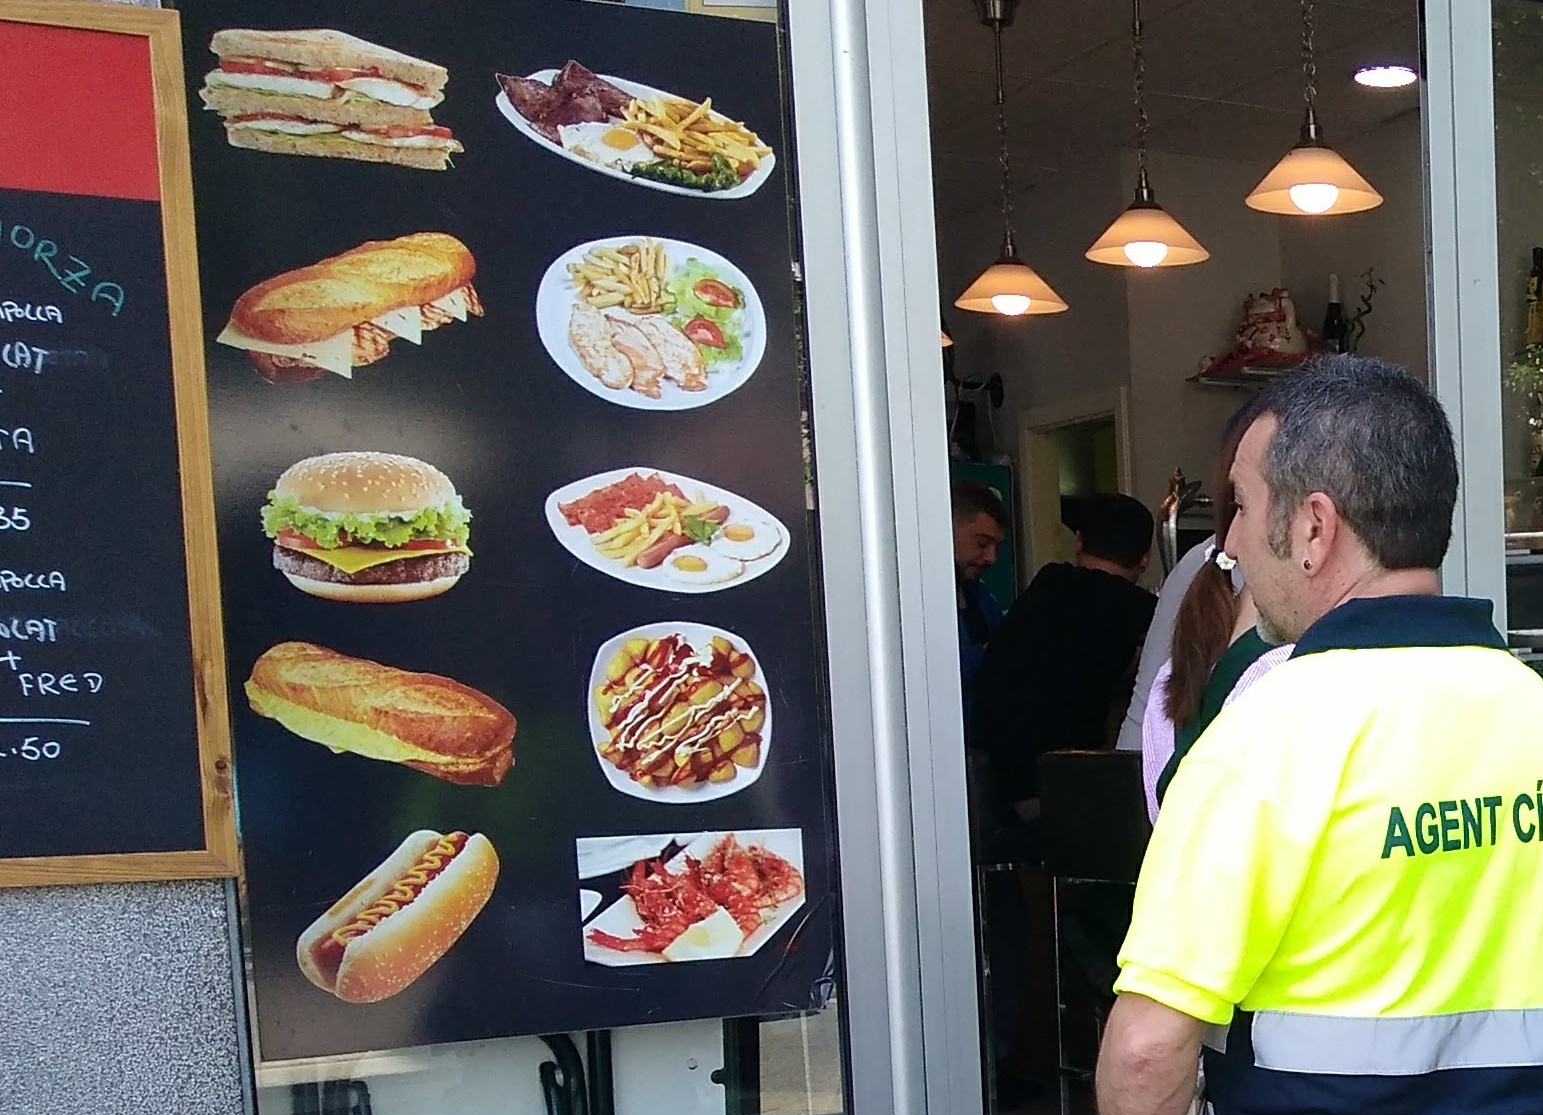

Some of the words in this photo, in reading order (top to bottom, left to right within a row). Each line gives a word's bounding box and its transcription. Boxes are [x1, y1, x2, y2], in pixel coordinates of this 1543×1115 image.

[0, 220, 125, 316] ORZA
[19, 673, 103, 697] FRED
[1381, 796, 1502, 859] AGENT
